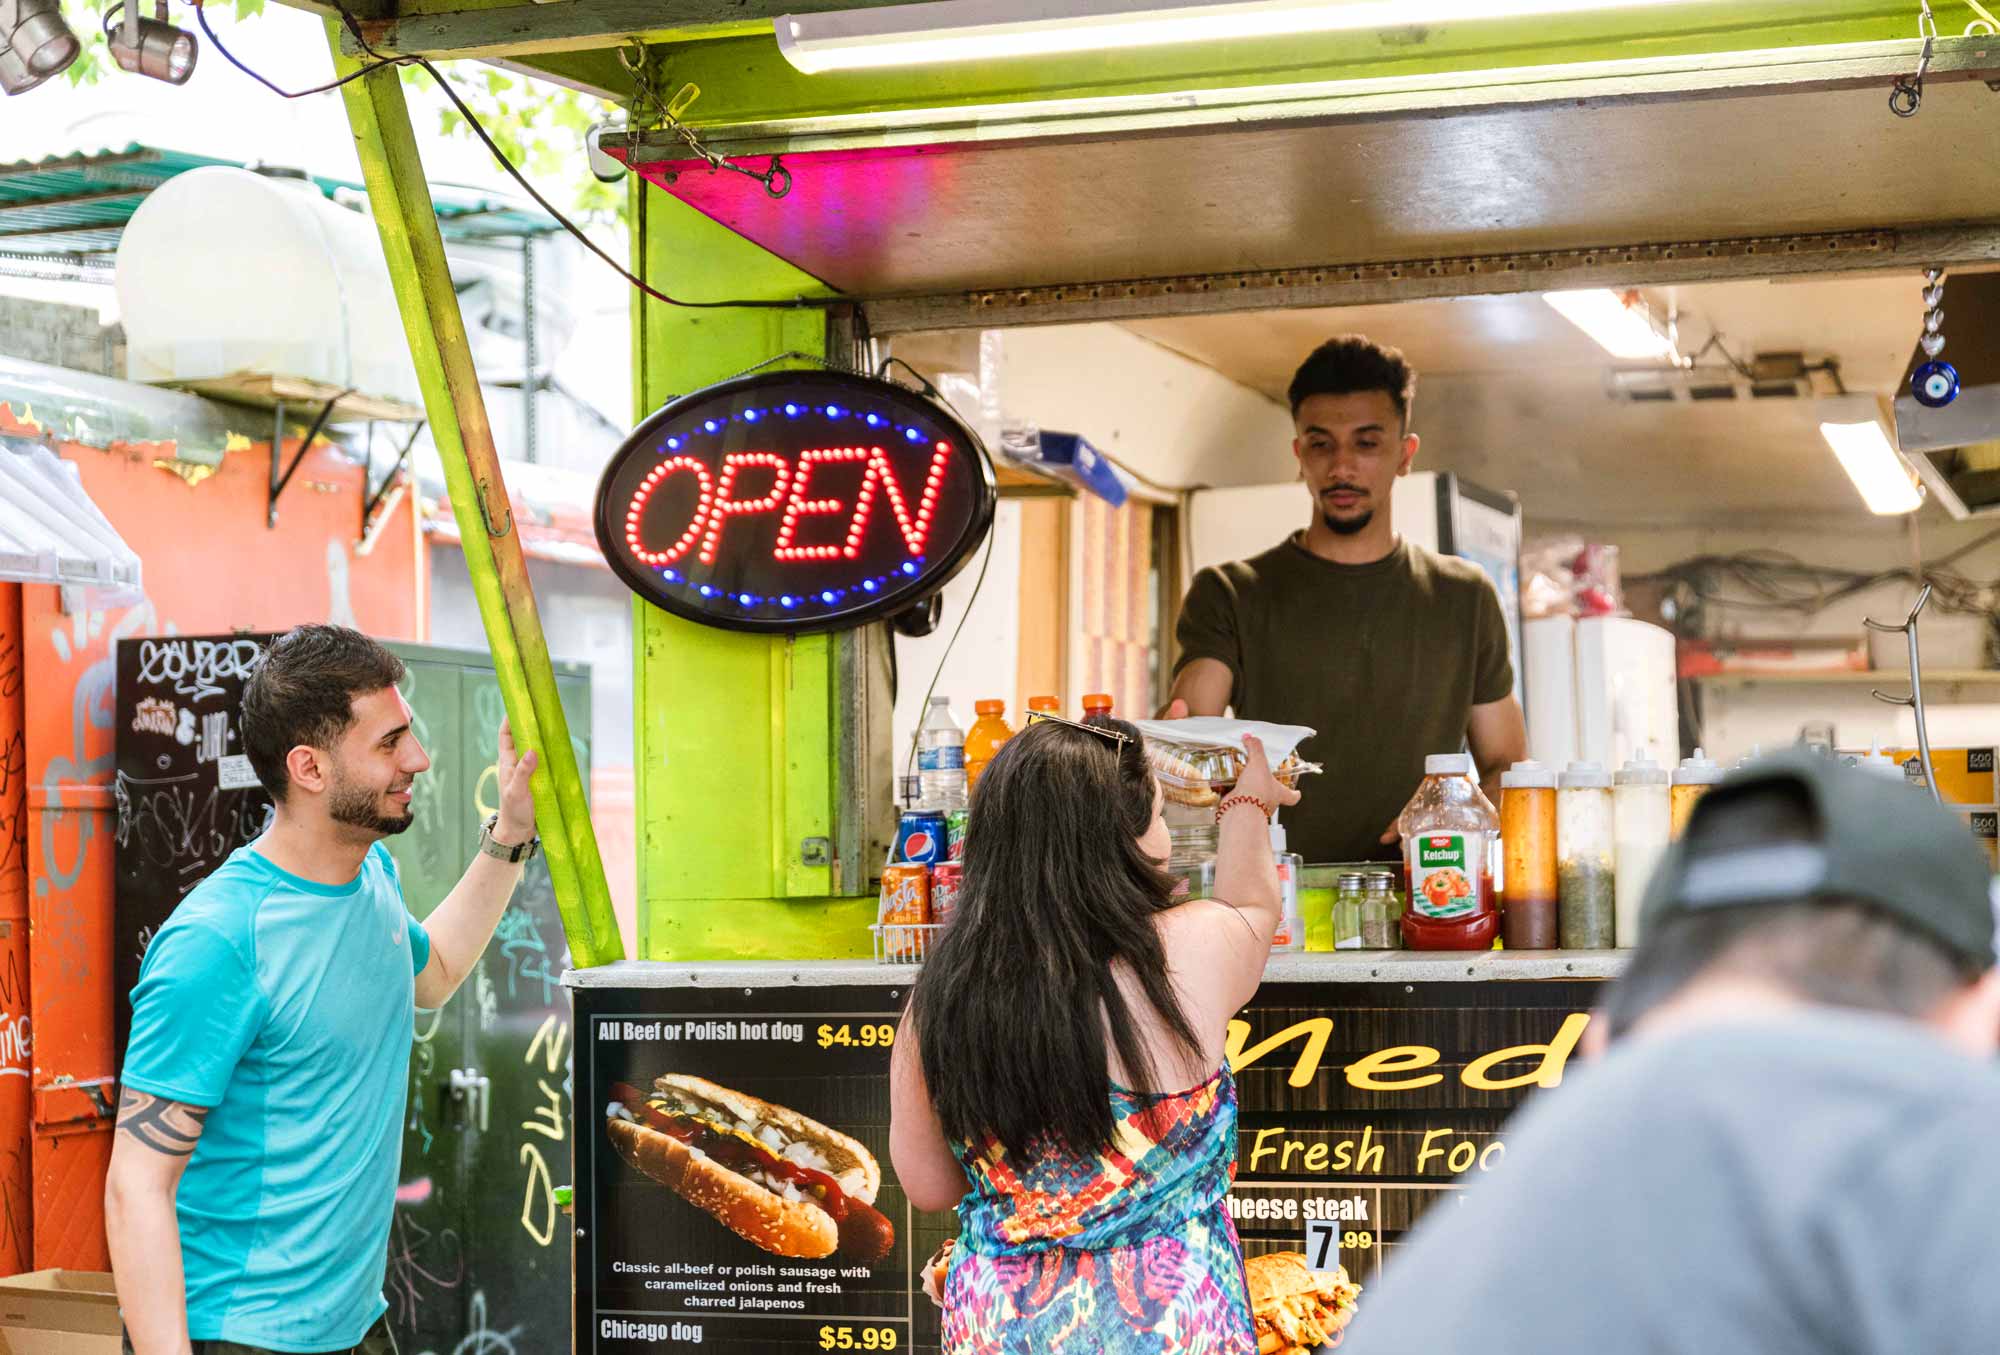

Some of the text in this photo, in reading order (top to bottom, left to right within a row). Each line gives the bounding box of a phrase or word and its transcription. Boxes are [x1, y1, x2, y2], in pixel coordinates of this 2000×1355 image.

[625, 441, 951, 565] OPEN
[1973, 817, 1996, 828] 500
[1423, 849, 1459, 861] Ketchup
[599, 1022, 803, 1043] All Beef or Polish hot dog
[816, 1023, 895, 1048] $4.99
[1249, 1125, 1506, 1174] Fresh Foo
[1221, 1194, 1369, 1221] heese steak
[612, 1261, 871, 1279] Classic all-beef or polish sausage with
[644, 1278, 842, 1294] caramelized onions and fresh
[684, 1295, 806, 1311] charred jalapenos
[601, 1319, 703, 1344] Chicago dog
[818, 1325, 897, 1351] $5.99
